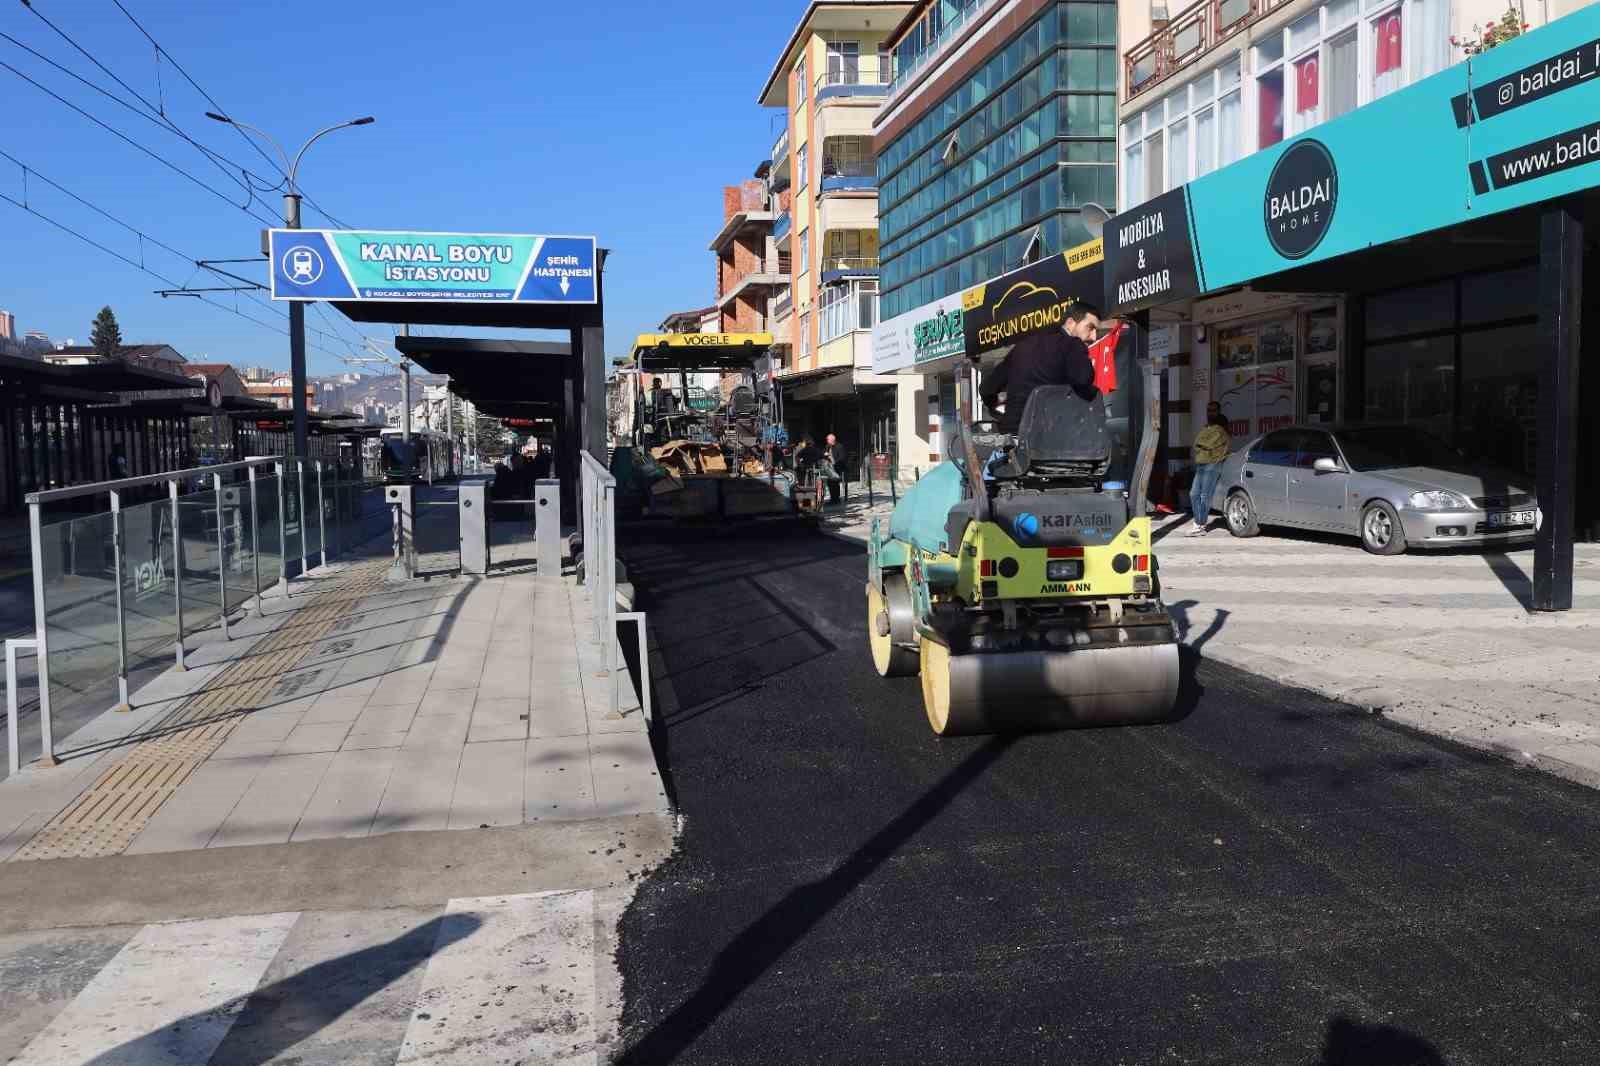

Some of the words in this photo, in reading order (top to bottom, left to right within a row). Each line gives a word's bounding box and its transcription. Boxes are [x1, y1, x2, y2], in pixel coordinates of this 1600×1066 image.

[1270, 178, 1330, 220] BALDAI
[1119, 211, 1164, 249] MOBİLYA
[1280, 210, 1320, 233] HOME
[361, 243, 442, 263] KANAL
[449, 244, 513, 264] BOYU
[547, 254, 579, 266] ŞEHİR
[1137, 248, 1146, 269] &
[385, 263, 491, 283] İSTASYONU
[1118, 269, 1171, 305] AKSESUAR
[978, 317, 1019, 345] COŞKUN
[1521, 511, 1532, 521] 125
[1040, 584, 1092, 594] AMMANN
